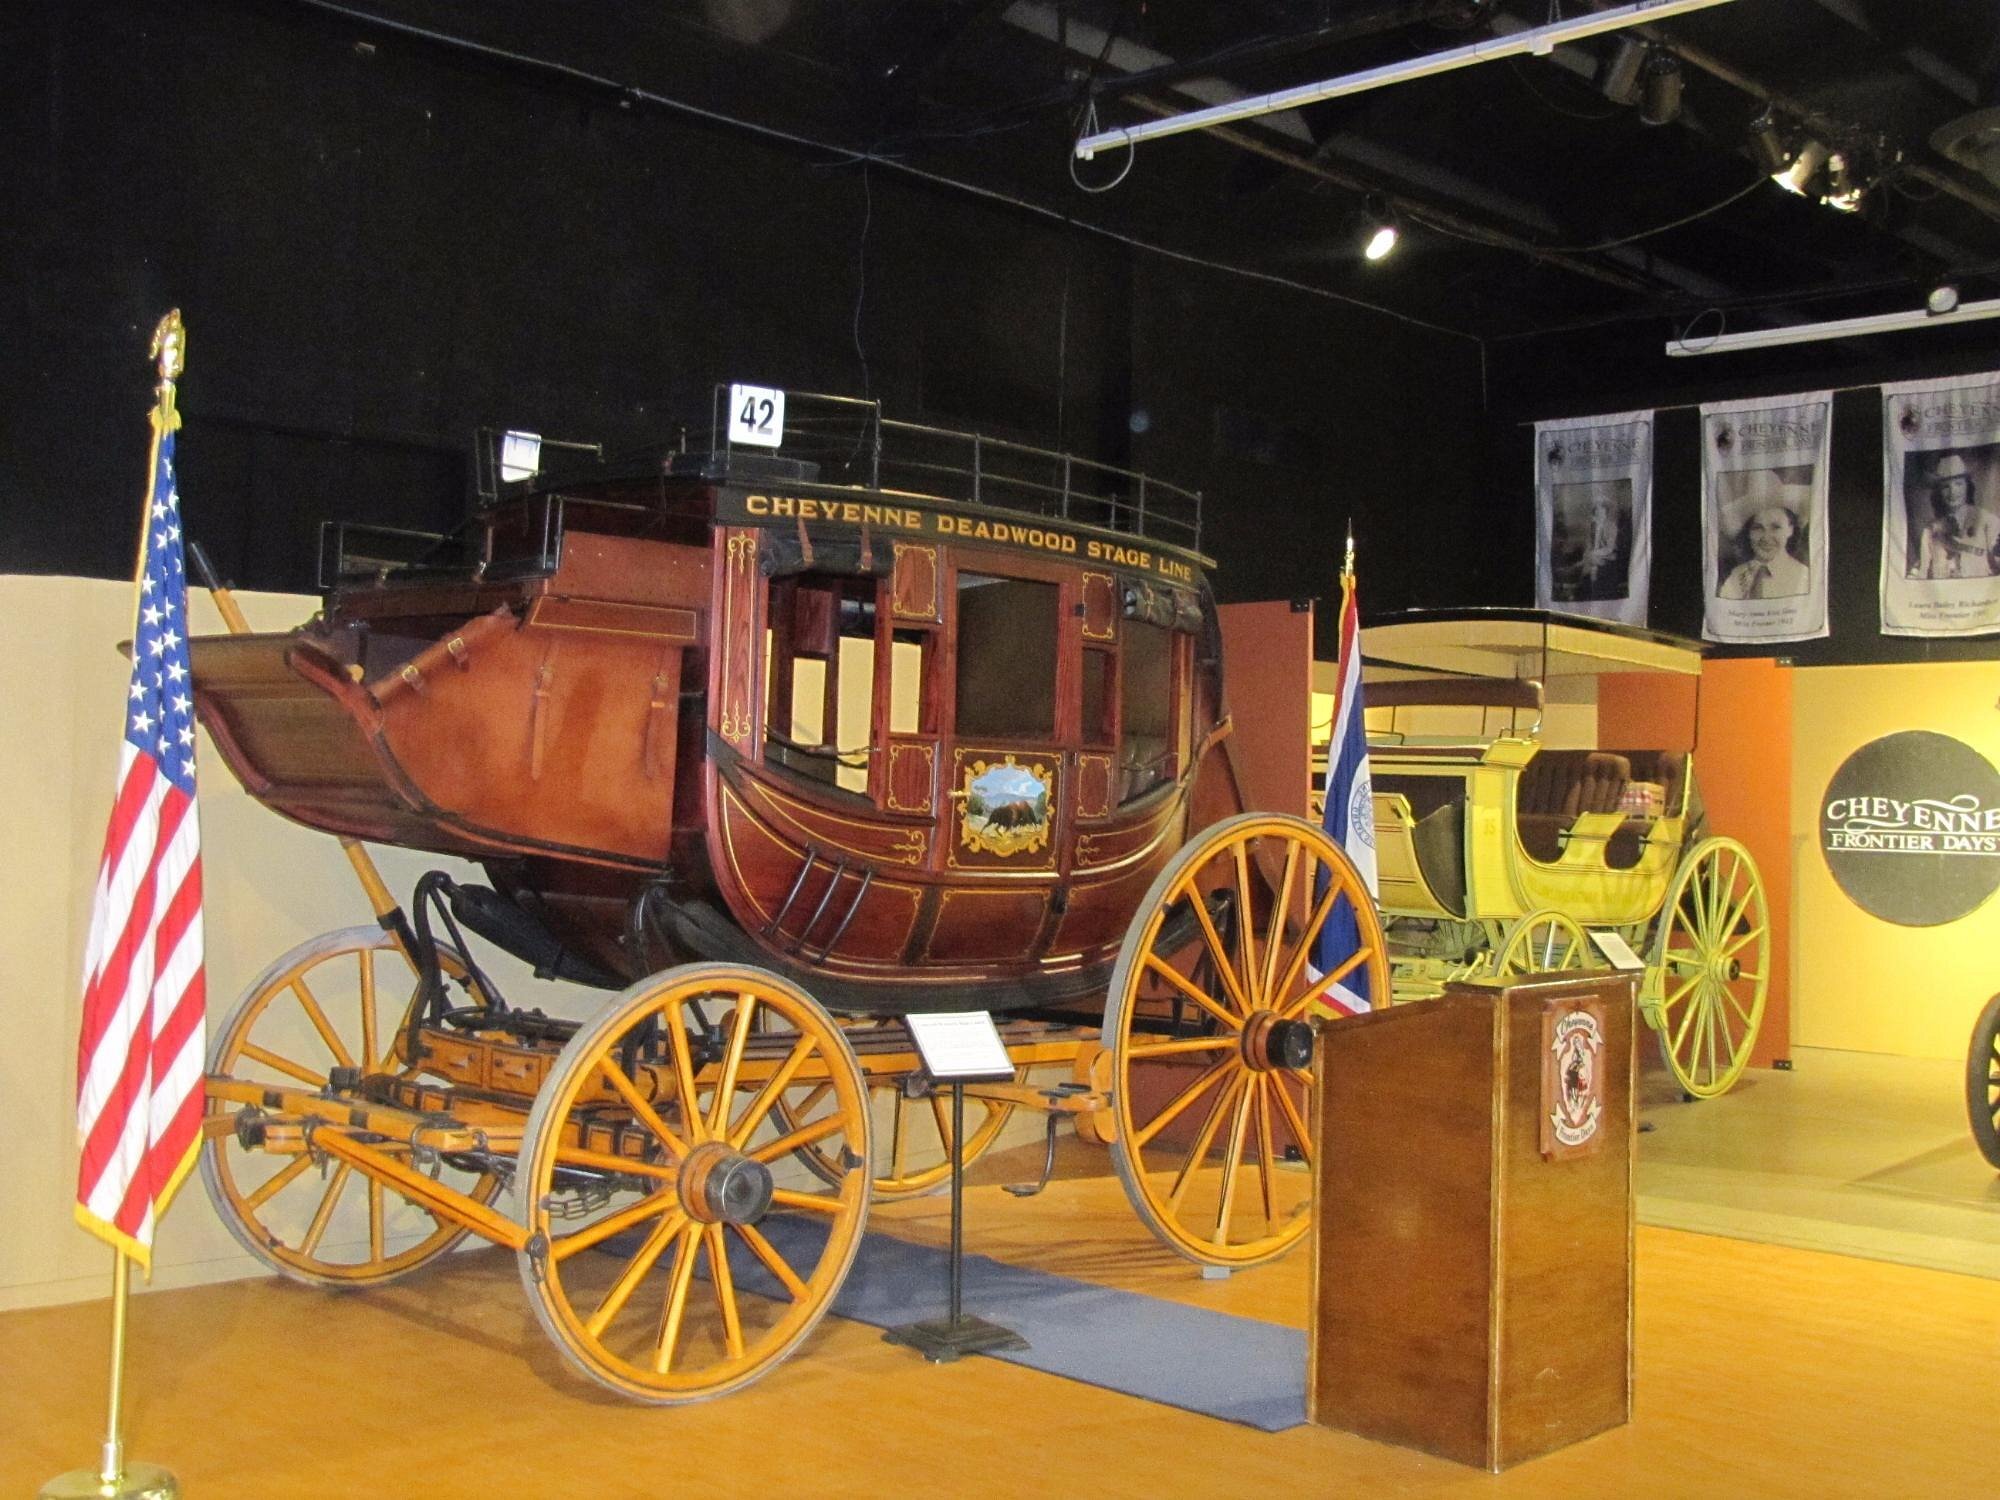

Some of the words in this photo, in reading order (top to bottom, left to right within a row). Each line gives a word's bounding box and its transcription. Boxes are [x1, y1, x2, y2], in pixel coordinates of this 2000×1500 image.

[740, 396, 774, 435] 42
[746, 496, 922, 529] CHEYENNE
[937, 514, 1077, 553] DEADWOOD
[1087, 540, 1151, 569] STAGE
[1159, 557, 1193, 582] LINE
[1826, 796, 2000, 833] CHEYENNE
[1831, 833, 1934, 850] FRONTIER
[1943, 835, 1997, 851] DAYS
